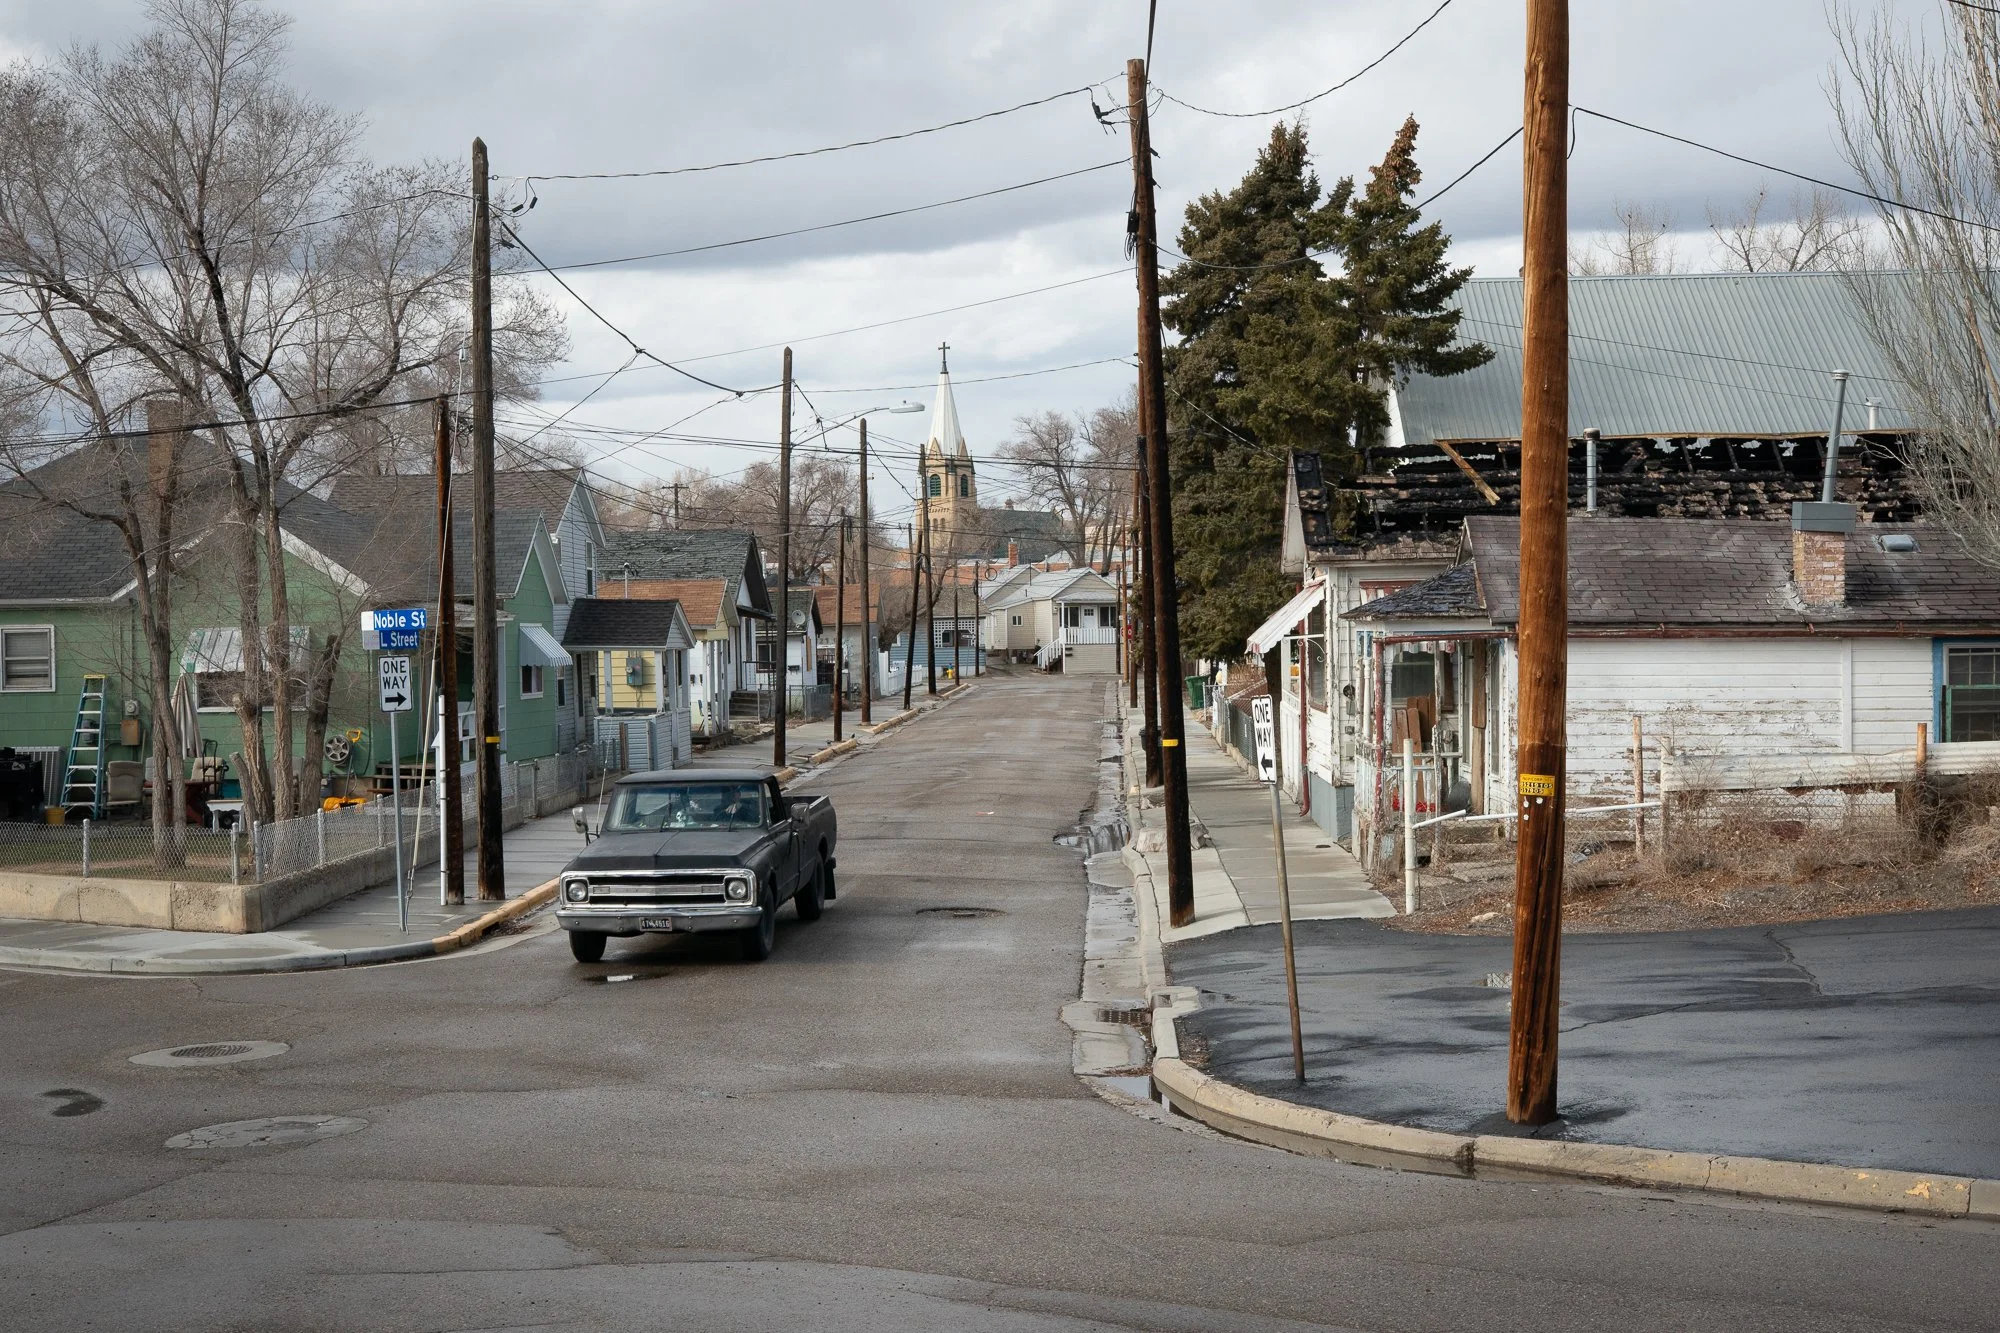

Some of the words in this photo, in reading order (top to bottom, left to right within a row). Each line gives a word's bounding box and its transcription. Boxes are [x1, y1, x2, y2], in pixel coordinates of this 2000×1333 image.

[374, 611, 406, 628] Noble
[411, 611, 425, 628] St
[380, 631, 388, 647] L
[390, 631, 418, 647] Street
[383, 660, 407, 674] ONE
[382, 676, 407, 689] WAY
[1254, 703, 1271, 723] ONE
[1255, 727, 1271, 747] WAY
